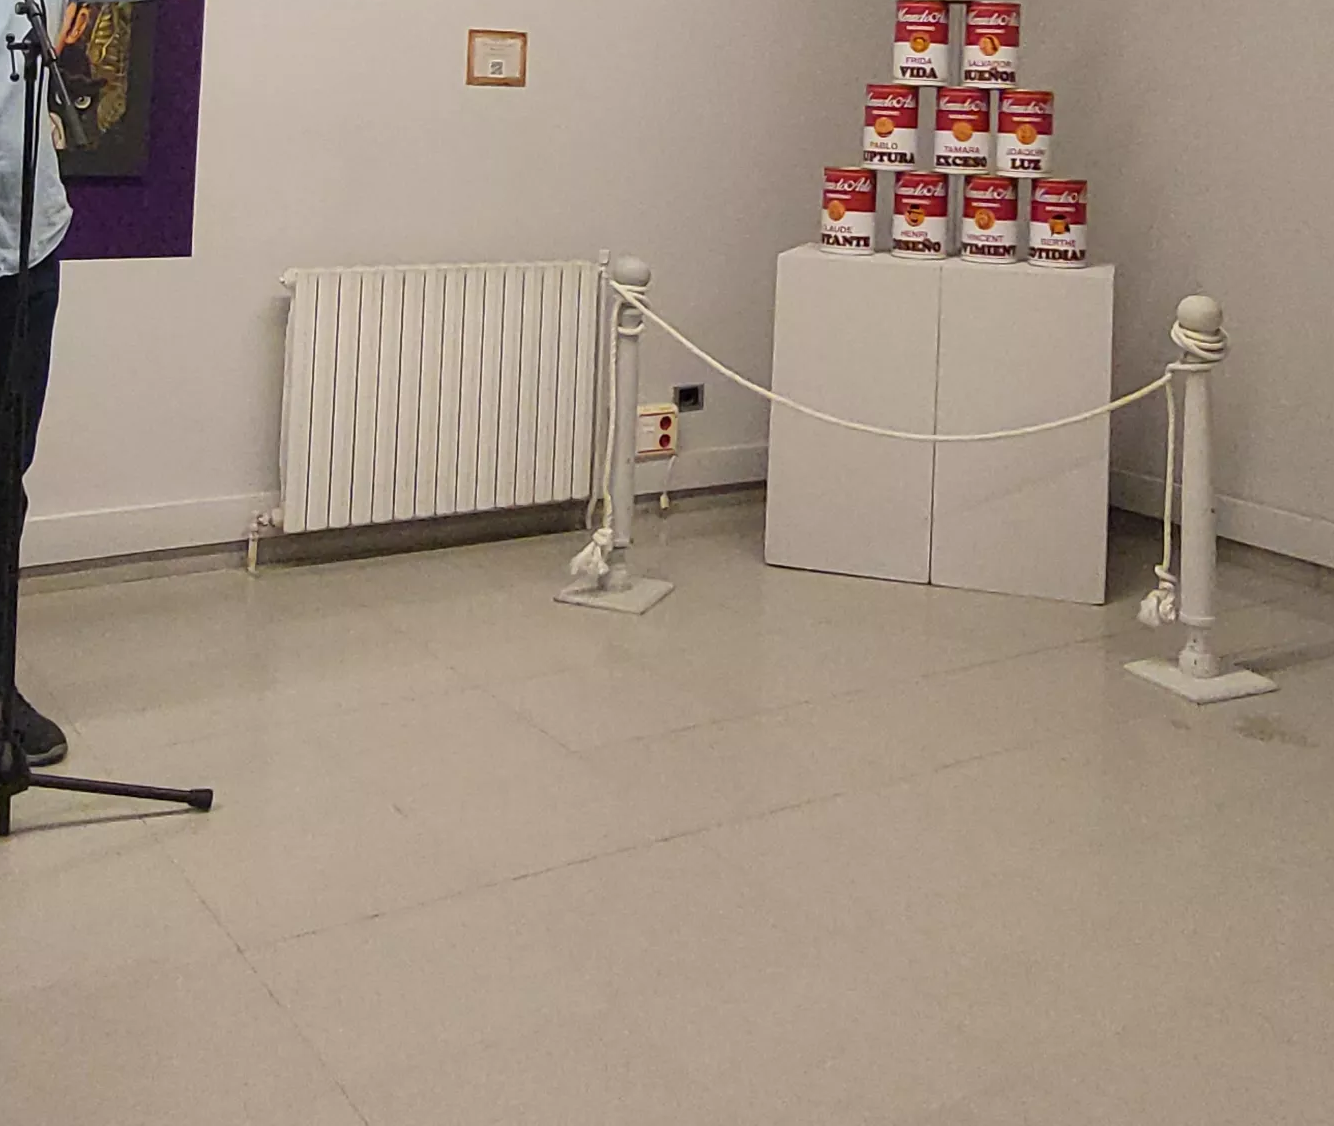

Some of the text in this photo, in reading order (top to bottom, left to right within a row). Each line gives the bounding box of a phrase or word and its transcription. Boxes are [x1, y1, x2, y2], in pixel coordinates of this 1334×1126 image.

[905, 56, 932, 65] FRIDA
[899, 65, 938, 80] VIDA
[870, 141, 898, 150] PABLO
[944, 145, 980, 154] TAMARA
[936, 154, 987, 168] EXCESO
[1010, 158, 1042, 170] LUZ
[1040, 238, 1076, 248] BERTHE
